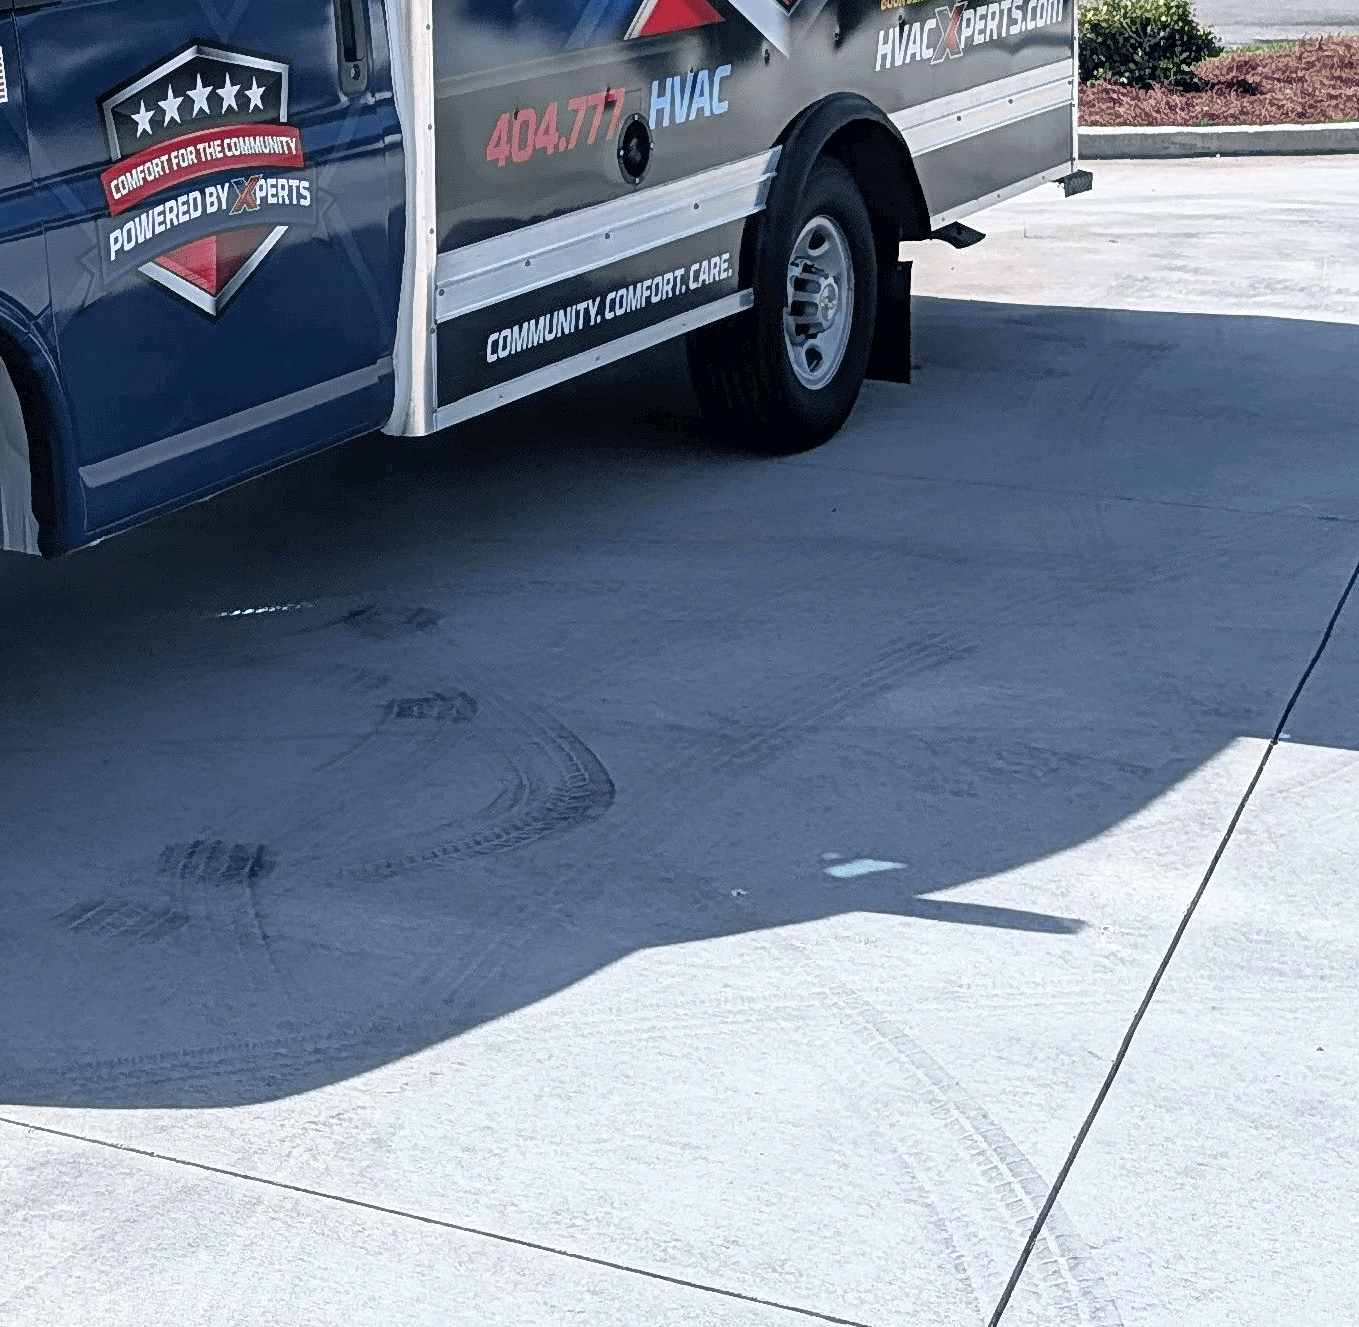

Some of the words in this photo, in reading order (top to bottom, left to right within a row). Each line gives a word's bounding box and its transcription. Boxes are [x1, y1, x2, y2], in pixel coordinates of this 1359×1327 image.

[649, 64, 732, 130] HVAC
[110, 158, 170, 200] COMFORT
[171, 147, 198, 171] FOR
[199, 139, 224, 162] THE
[224, 136, 297, 155] COMMUNITY
[109, 190, 202, 261] POWERED
[205, 183, 230, 214] BY
[229, 174, 311, 215] XPERTS
[486, 295, 601, 363] COMMUNITY.
[604, 268, 686, 320] COMFORT.
[689, 253, 733, 290] CARE.
